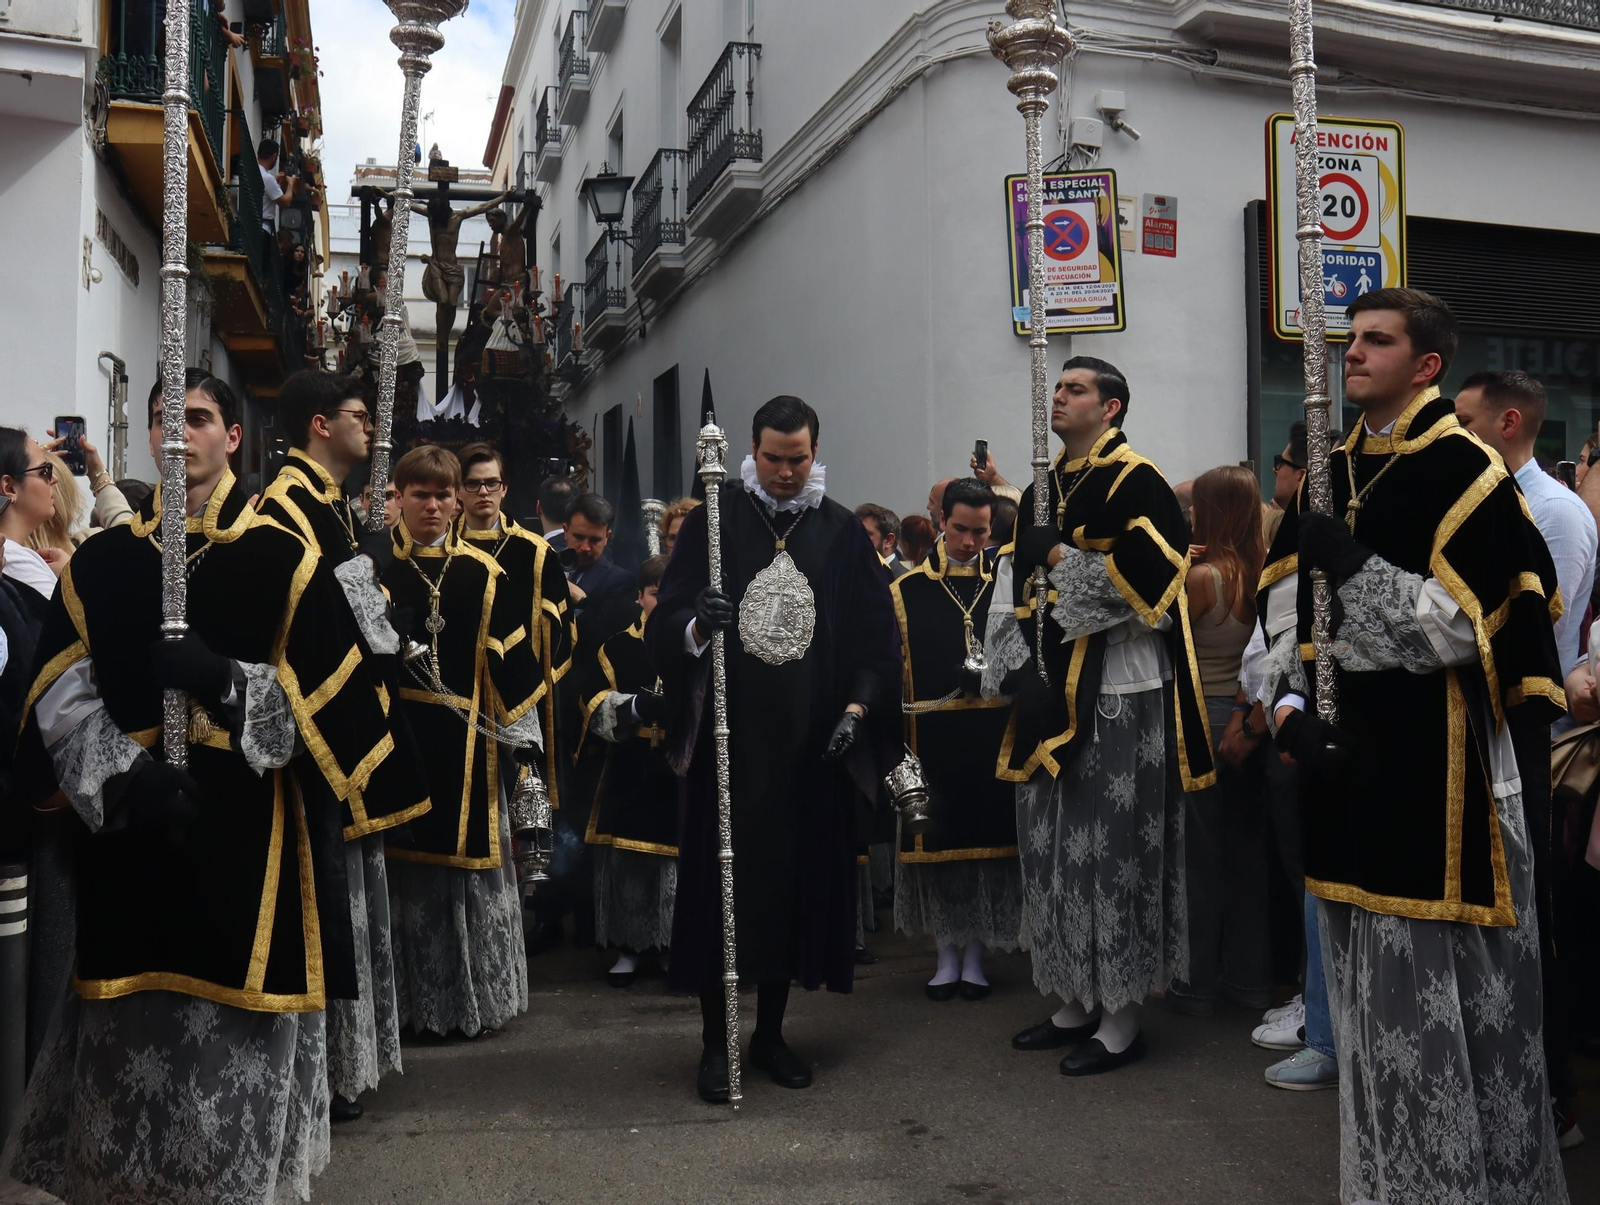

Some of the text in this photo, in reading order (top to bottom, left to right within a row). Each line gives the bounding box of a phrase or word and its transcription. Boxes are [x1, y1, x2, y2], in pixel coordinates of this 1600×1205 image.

[1290, 131, 1388, 151] AENCIÓN
[1318, 157, 1362, 172] ZONA
[1017, 178, 1105, 192] PLN ESPECIAL
[1068, 189, 1107, 200] SANTA
[1322, 194, 1356, 218] 20
[1145, 219, 1174, 230] Alarma
[1047, 273, 1091, 281] EVACUACIÓN
